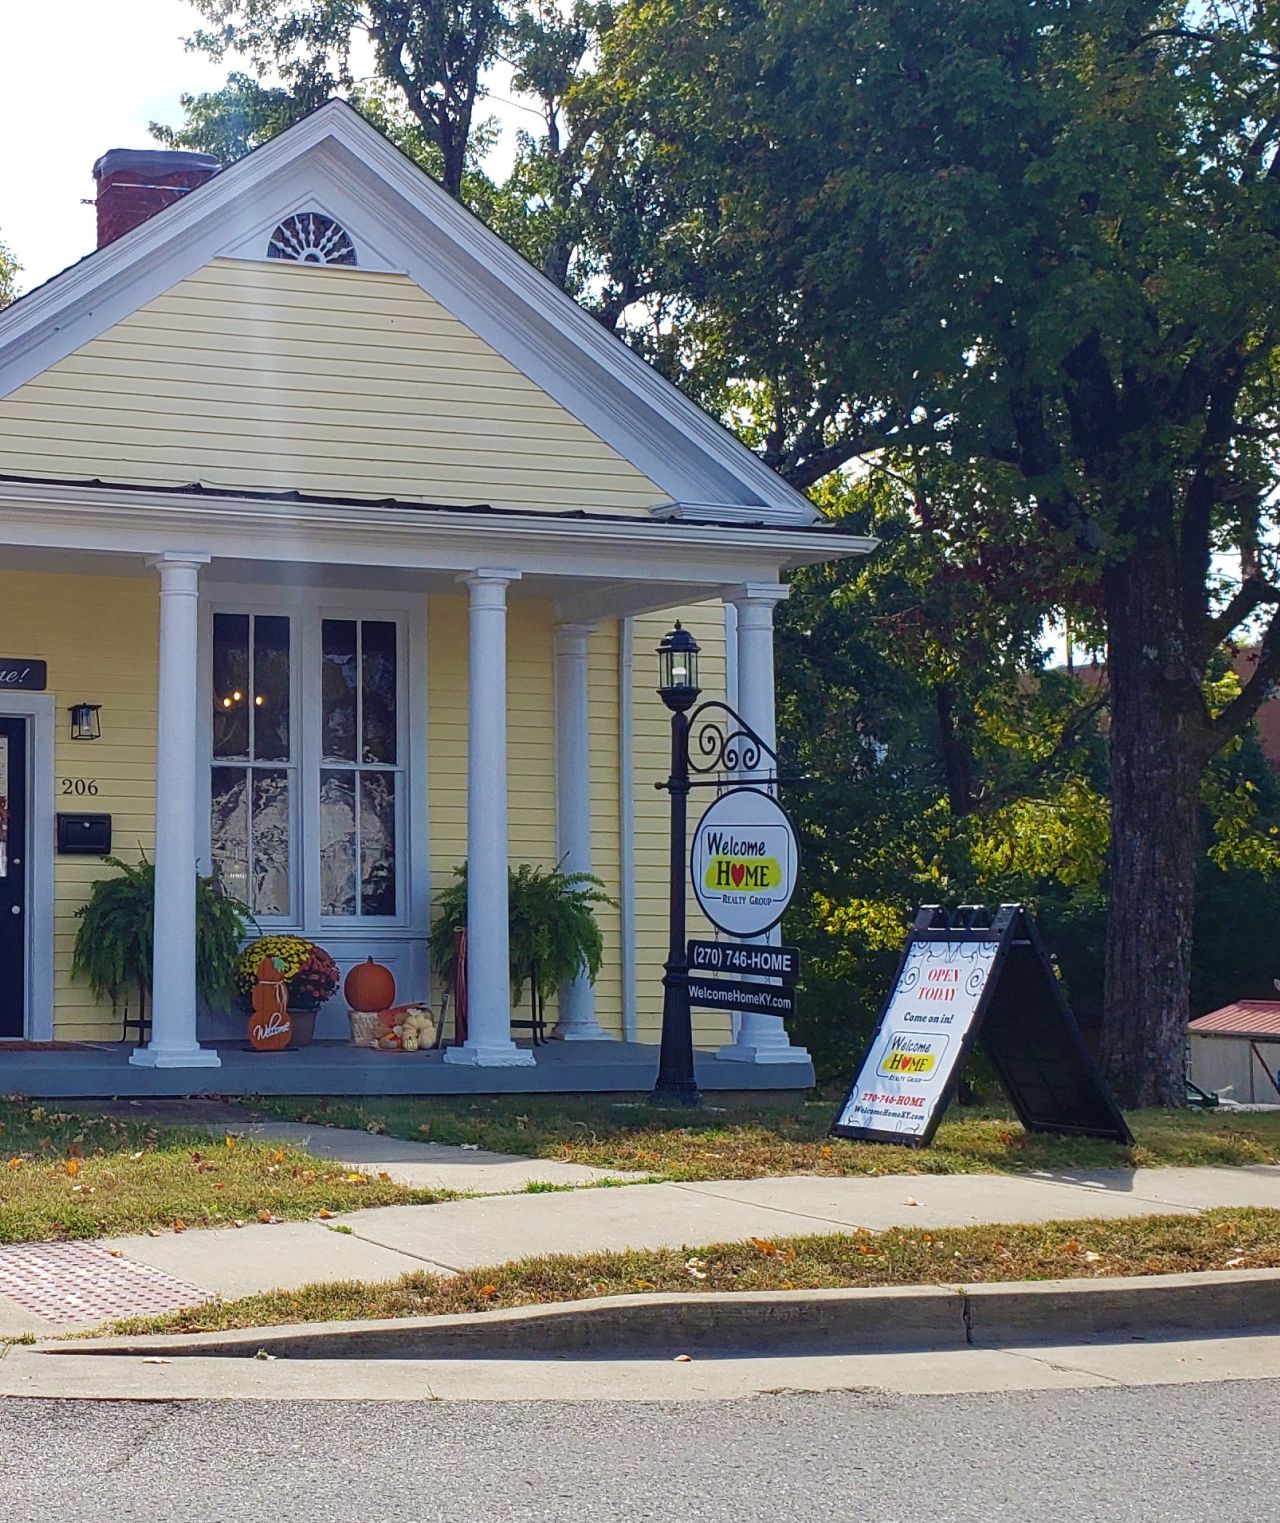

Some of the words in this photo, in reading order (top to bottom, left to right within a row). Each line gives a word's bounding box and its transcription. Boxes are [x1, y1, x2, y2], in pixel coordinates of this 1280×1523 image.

[61, 778, 99, 796] 206
[707, 831, 766, 857] Welcome
[722, 894, 746, 905] REALTY
[749, 895, 772, 906] GROUP
[693, 945, 723, 968] (270)
[726, 949, 792, 972] 746-HOME
[927, 968, 961, 982] OPEN
[688, 984, 791, 1010] WelcomeHomeKY.com
[917, 987, 958, 1001] TODAY
[903, 1011, 927, 1024] Come
[928, 1015, 939, 1024] on
[940, 1013, 954, 1025] in!
[890, 1035, 931, 1053] Welcome
[862, 1092, 926, 1108] 270-746-HOME
[854, 1104, 925, 1121] WelcomeHomeKY.com
